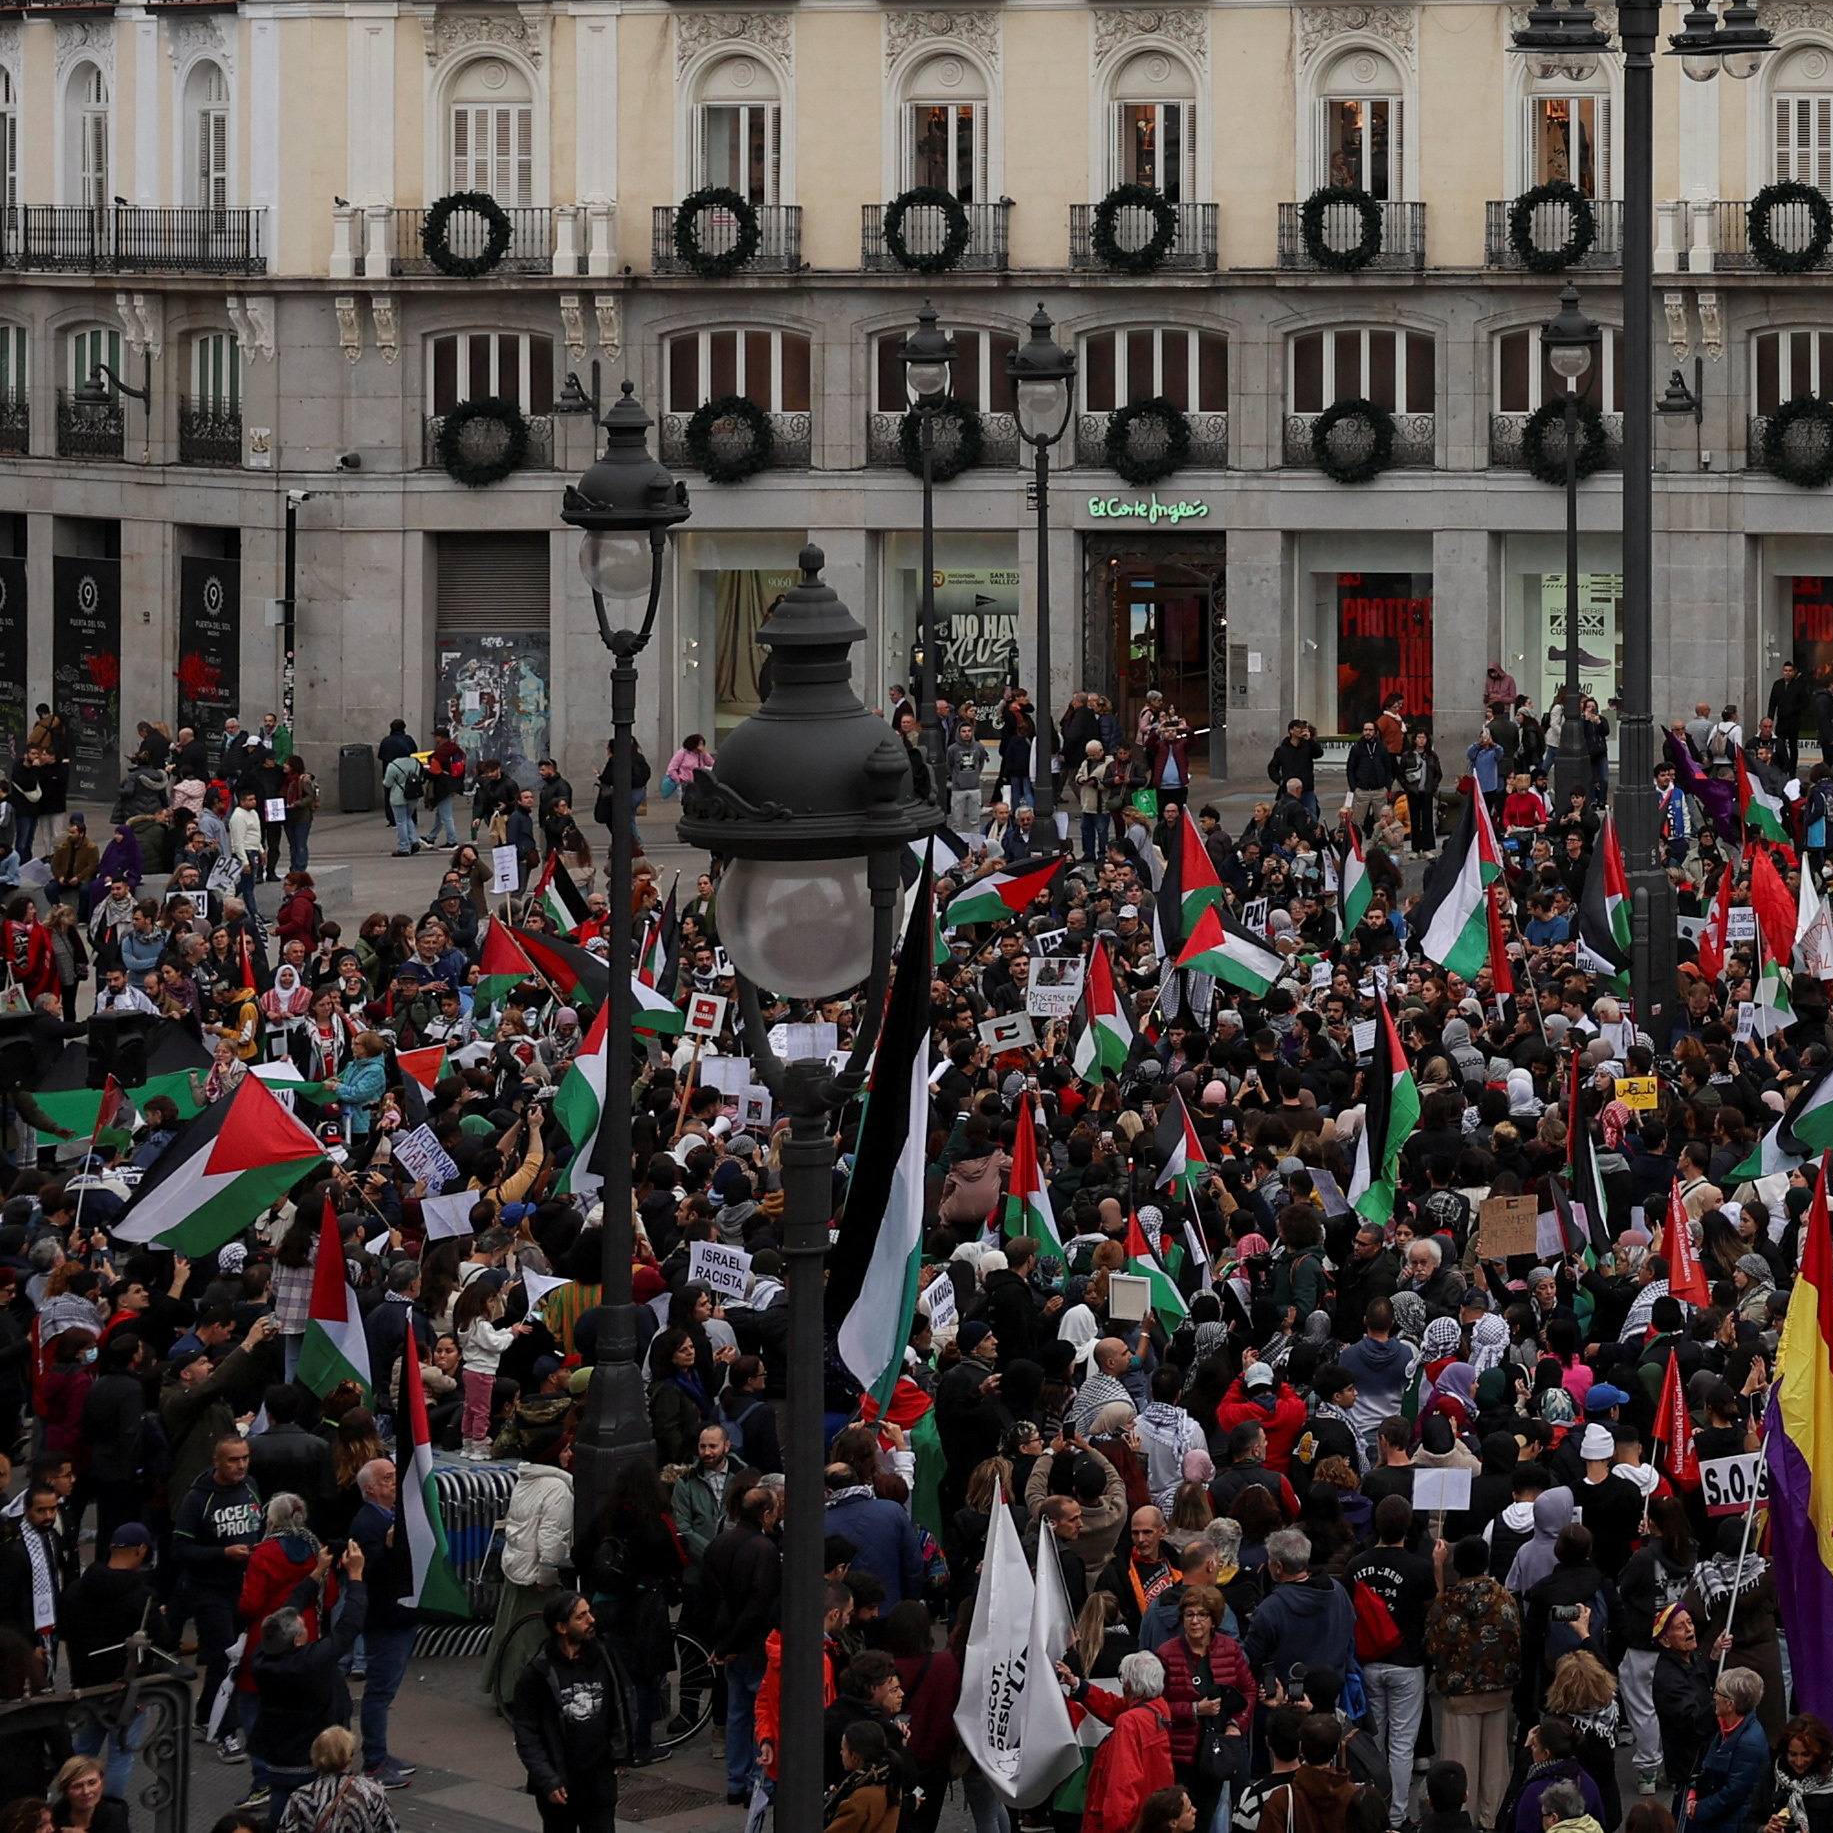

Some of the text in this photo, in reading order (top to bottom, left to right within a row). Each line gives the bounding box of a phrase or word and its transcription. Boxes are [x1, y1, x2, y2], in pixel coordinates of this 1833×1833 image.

[1088, 492, 1208, 524] El Corte Inglés
[83, 584, 92, 603] 9
[208, 584, 218, 604] 9
[768, 577, 792, 588] 9060
[951, 614, 979, 639] NO
[213, 857, 242, 882] PAZ
[1244, 900, 1265, 928] PAZ
[1031, 1001, 1047, 1014] PAZ
[400, 1136, 428, 1173] MATA
[701, 1247, 745, 1273] ISRAEL,
[1677, 1231, 1692, 1282] Estudiantes
[695, 1266, 744, 1292] RACISTA.
[1673, 1416, 1684, 1474] Sindicato de
[986, 1662, 1005, 1748] BOICOT,
